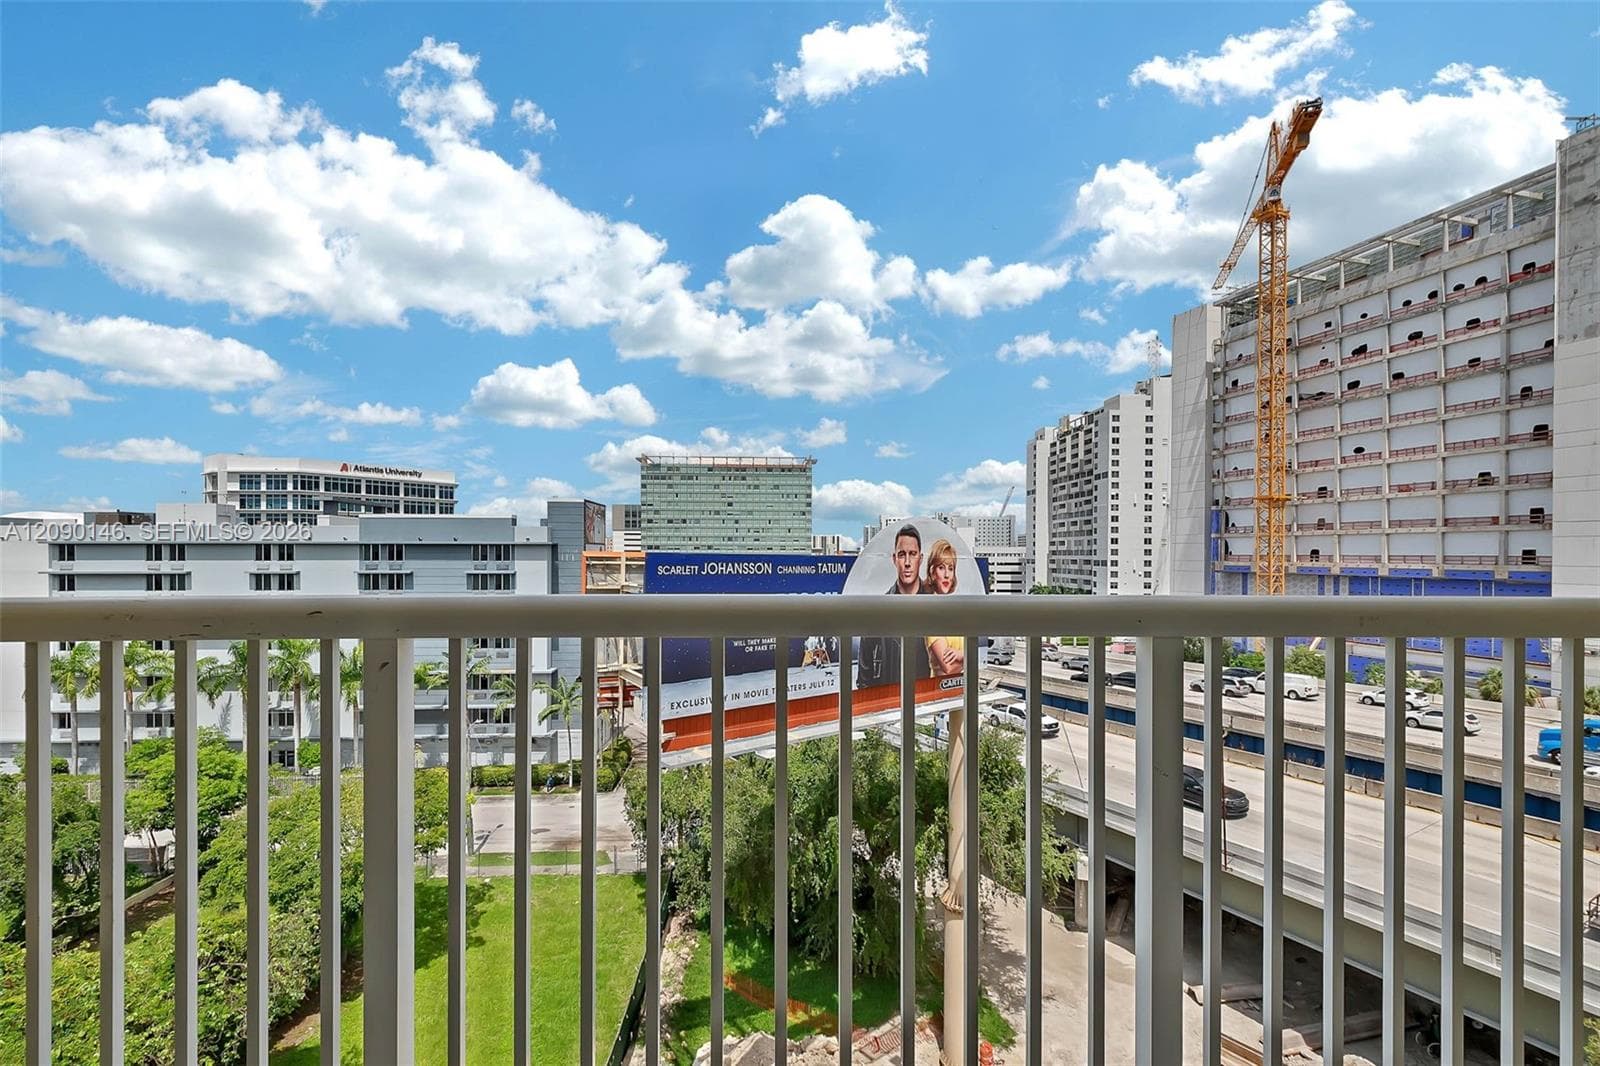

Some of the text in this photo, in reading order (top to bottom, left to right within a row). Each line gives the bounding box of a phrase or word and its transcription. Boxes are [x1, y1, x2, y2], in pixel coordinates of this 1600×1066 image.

[353, 465, 384, 474] Atlantis
[385, 467, 423, 478] University
[657, 562, 847, 575] SCARLETT JOHANSSON CHANNING TATUM
[942, 676, 966, 688] CARTE
[670, 694, 728, 710] EXCLUSIVY
[731, 692, 741, 701] IN
[743, 688, 769, 699] MOVIE
[808, 681, 825, 690] JULY
